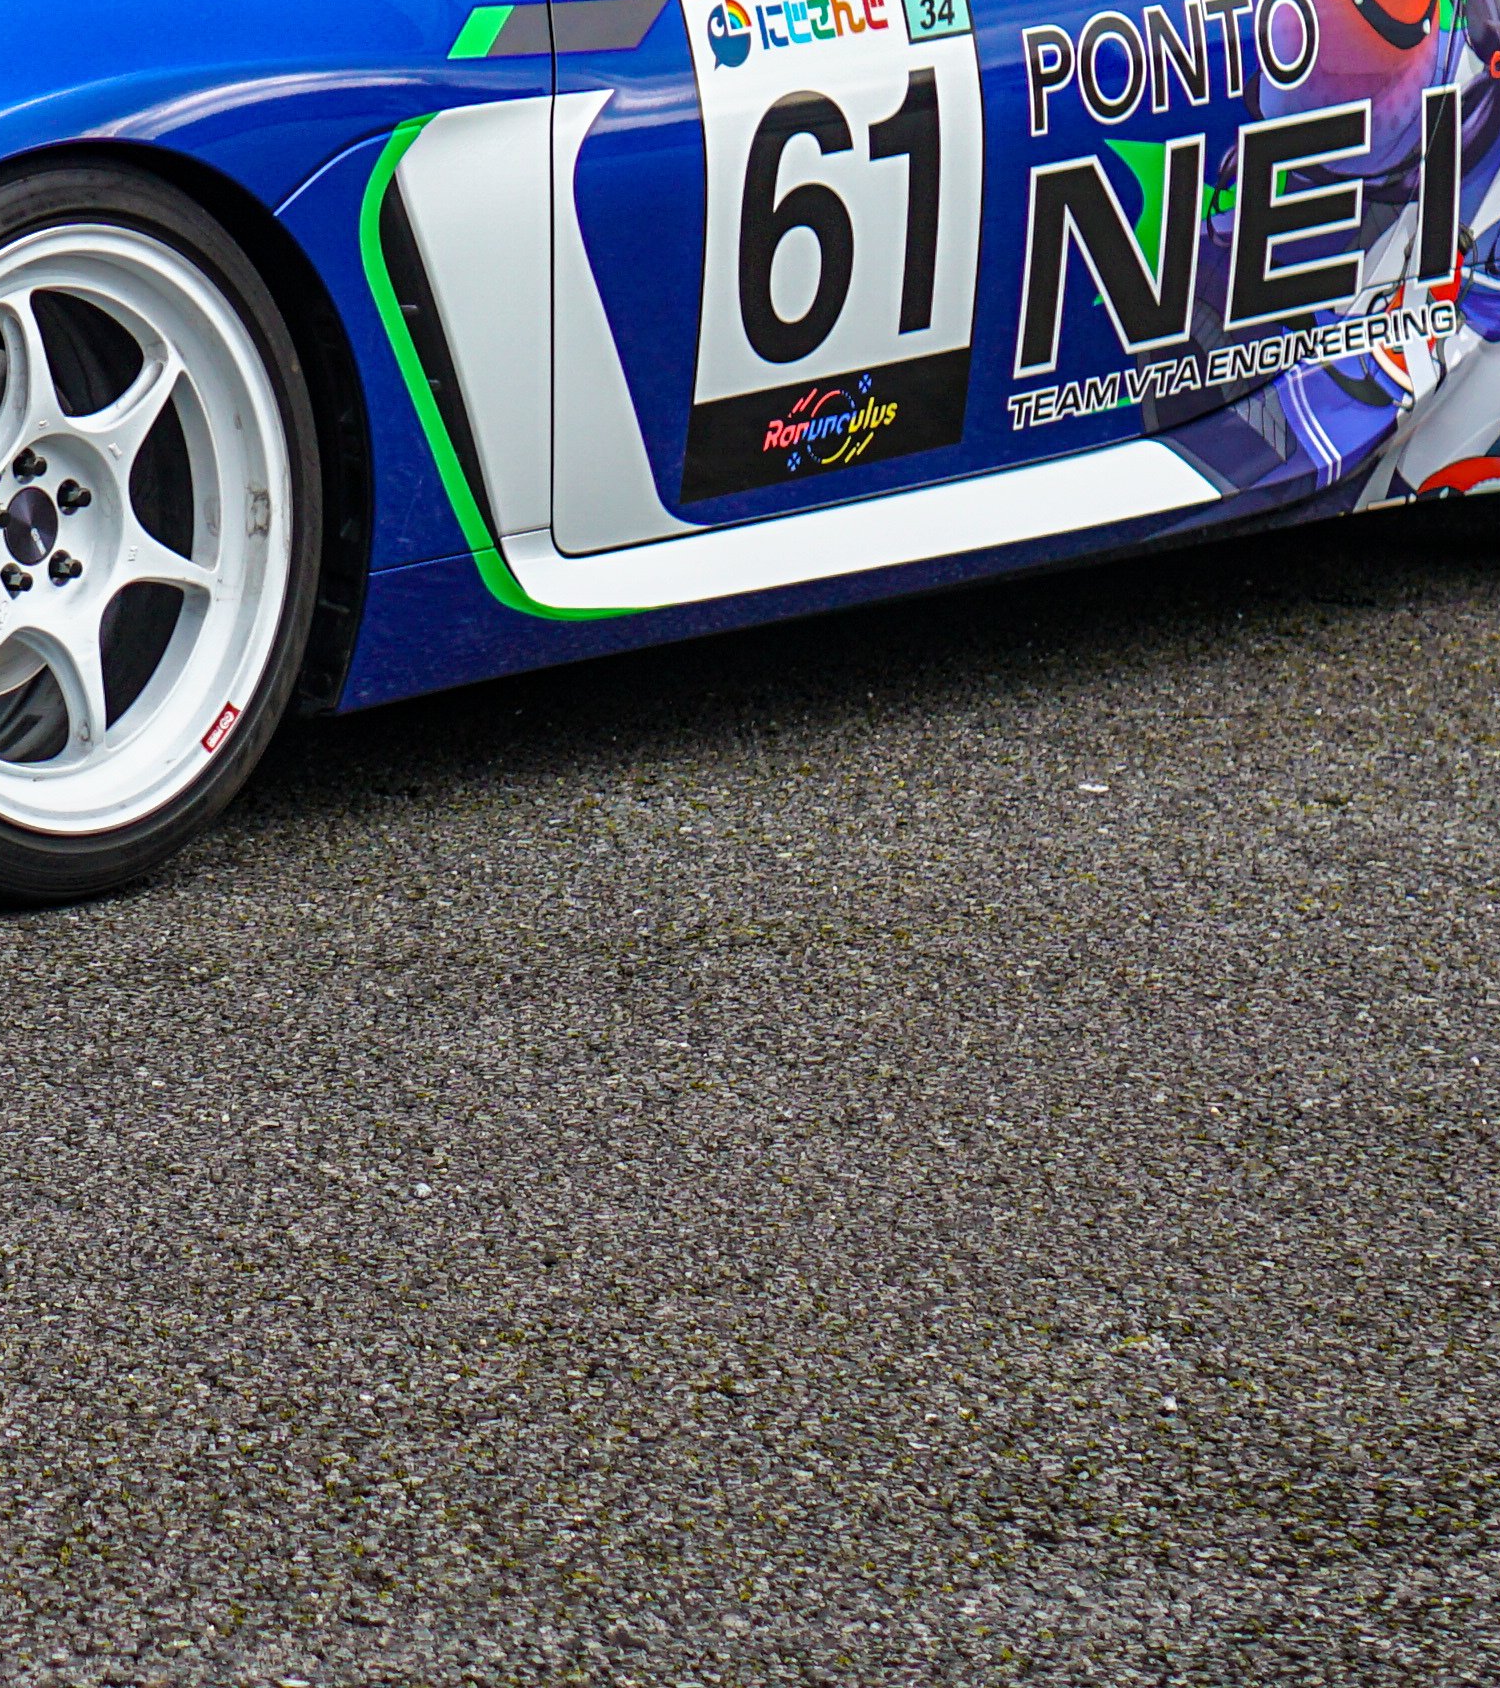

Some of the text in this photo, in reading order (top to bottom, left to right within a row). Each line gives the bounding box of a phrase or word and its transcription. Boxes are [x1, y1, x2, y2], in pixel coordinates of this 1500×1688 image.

[738, 65, 942, 365] 61
[1007, 298, 1458, 431] TEAM VTA ENGINEERING
[1012, 82, 1463, 381] NEI
